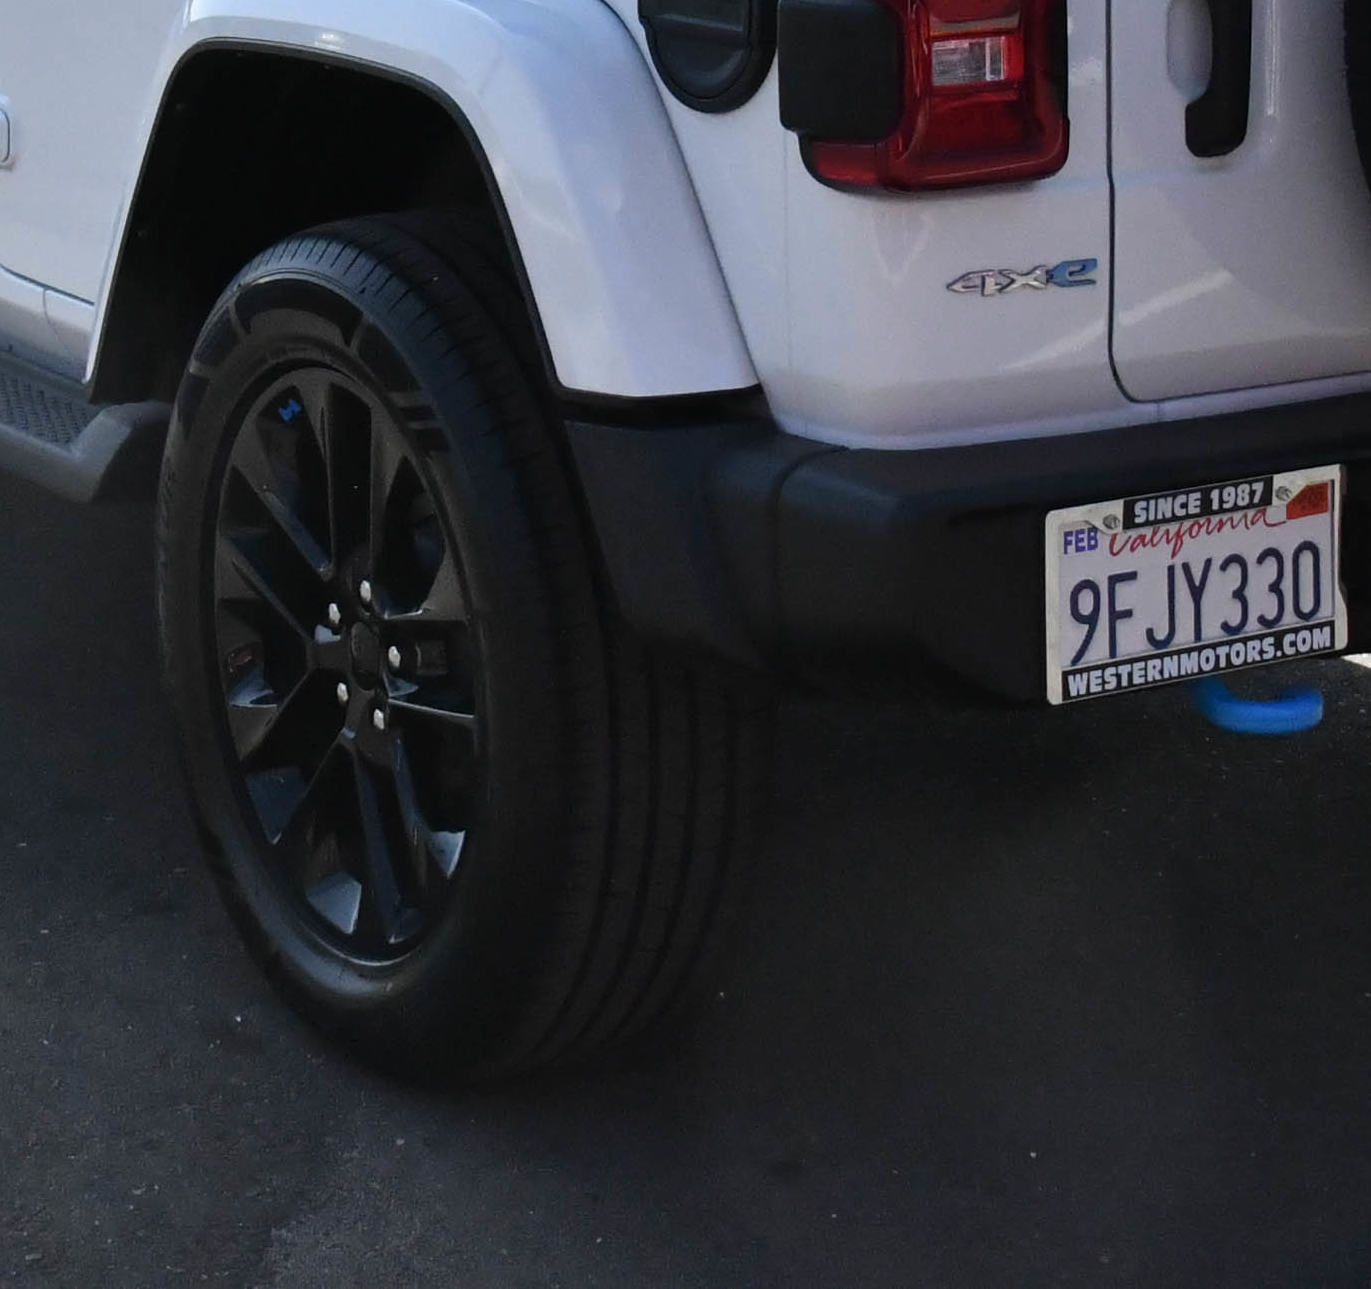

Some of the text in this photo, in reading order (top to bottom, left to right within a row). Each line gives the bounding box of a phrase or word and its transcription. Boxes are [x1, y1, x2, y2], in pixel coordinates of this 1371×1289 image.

[1133, 491, 1202, 524] SINCE
[1210, 481, 1265, 511] 1987
[1063, 526, 1099, 555] FEB
[1070, 540, 1321, 667] 9FJY330
[1068, 625, 1332, 698] WESTERNMOTORS.COM
